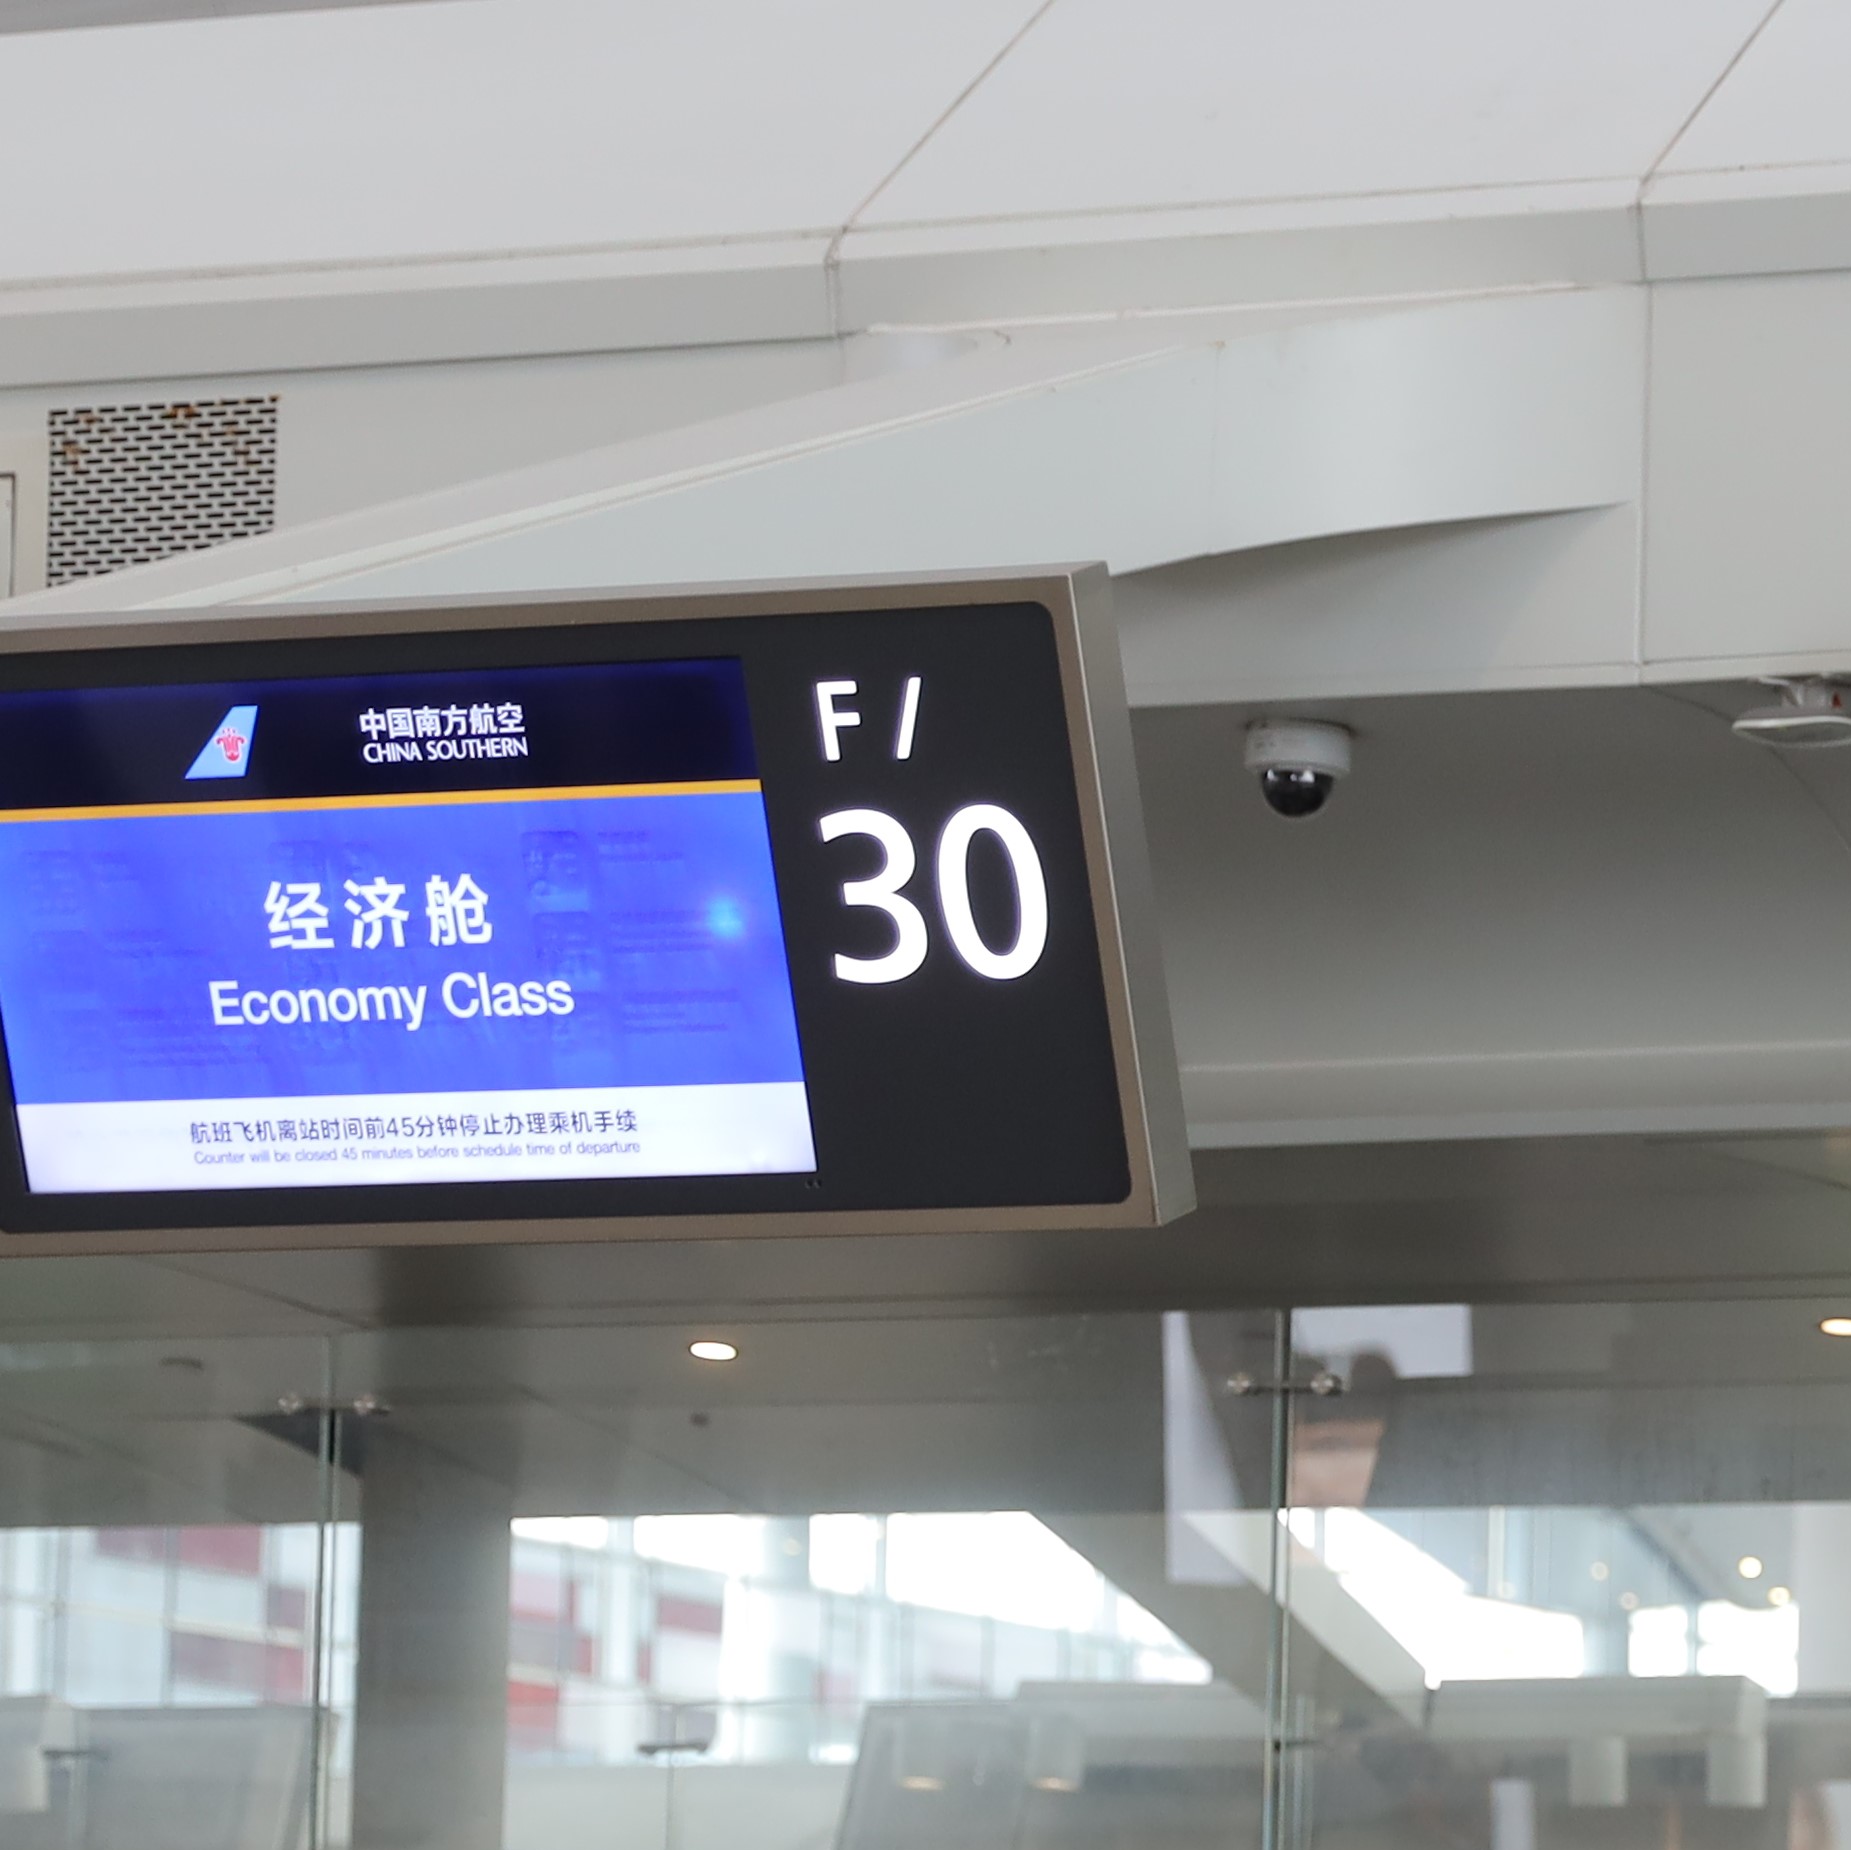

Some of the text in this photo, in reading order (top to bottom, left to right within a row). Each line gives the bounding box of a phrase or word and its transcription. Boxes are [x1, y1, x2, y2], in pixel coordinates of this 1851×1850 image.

[360, 704, 525, 740] 中国南方航空
[363, 735, 528, 764] CHINA SOUTHERN
[263, 872, 492, 951] 经济舱
[818, 803, 1048, 985] 30
[208, 970, 574, 1031] Economy Class
[295, 1148, 337, 1161] closed
[342, 1148, 357, 1160] 45
[362, 1147, 412, 1160] minutes
[416, 1145, 458, 1158] before
[526, 1143, 554, 1155] time
[577, 1141, 640, 1156] departure
